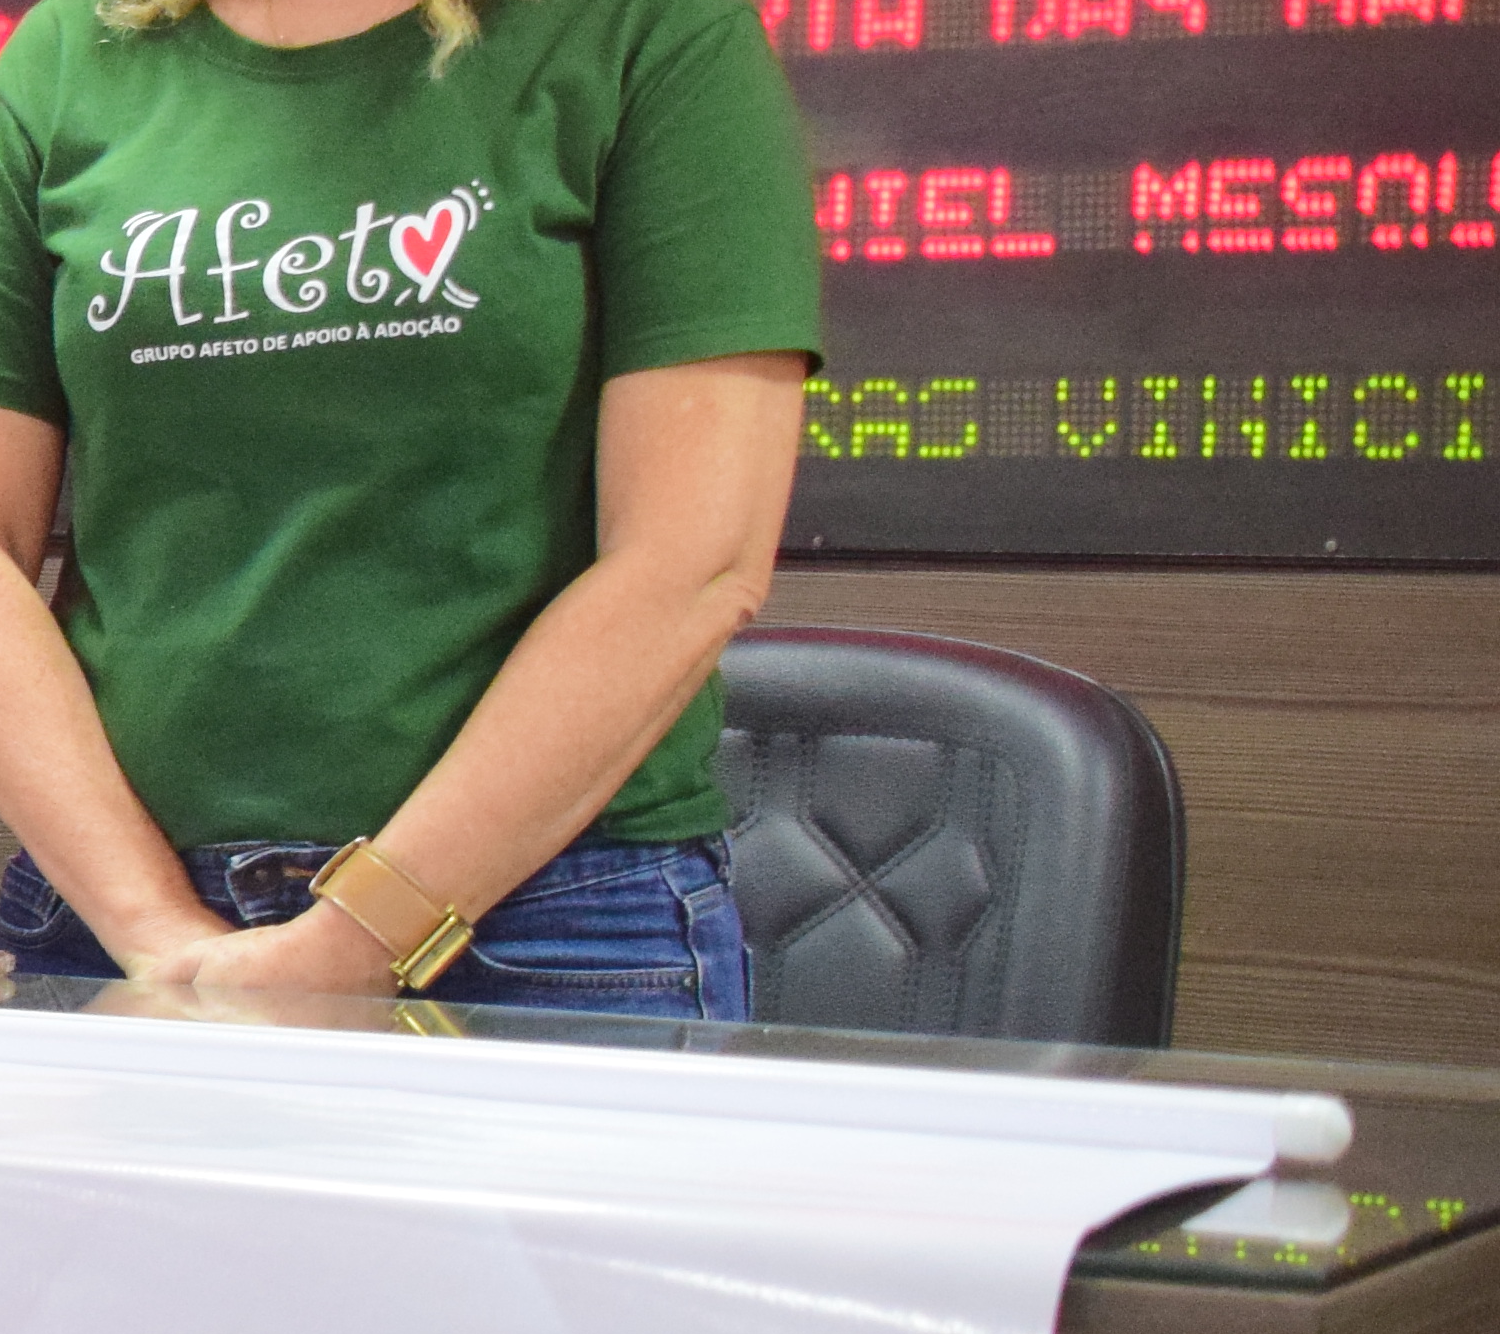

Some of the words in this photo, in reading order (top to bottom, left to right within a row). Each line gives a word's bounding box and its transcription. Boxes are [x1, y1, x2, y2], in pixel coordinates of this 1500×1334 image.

[130, 342, 196, 365] GRUPO
[199, 338, 259, 359] AFETO
[262, 334, 288, 352] DE
[291, 325, 352, 349] APOIO
[355, 321, 371, 340] À
[374, 314, 462, 339] ADOÇÃO
